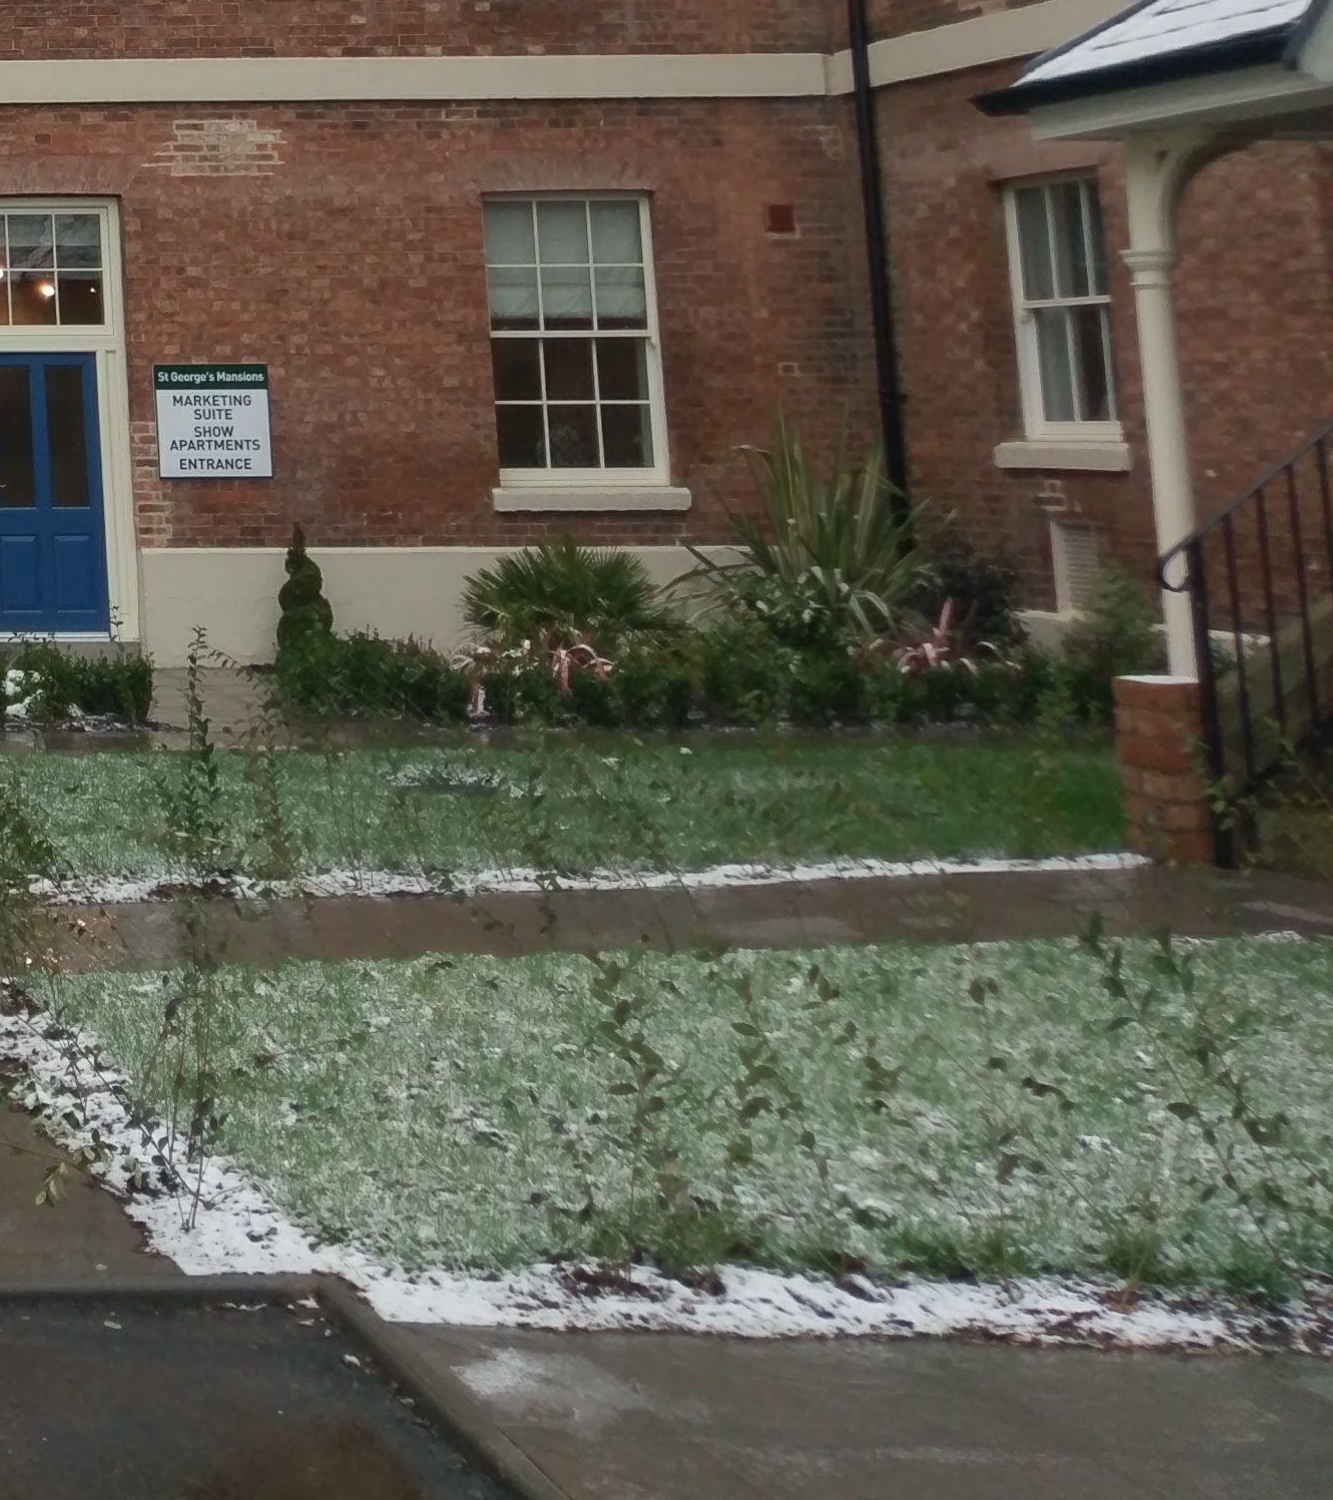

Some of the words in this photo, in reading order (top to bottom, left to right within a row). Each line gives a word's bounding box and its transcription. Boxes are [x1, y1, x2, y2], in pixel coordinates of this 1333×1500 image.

[157, 371, 169, 382] St
[170, 371, 215, 384] George's
[216, 371, 265, 382] Mansions
[172, 395, 252, 406] MARKETING
[193, 408, 233, 420] SUITE
[193, 426, 234, 438] SHOW
[169, 439, 261, 451] APARTMENTS
[179, 458, 252, 470] ENTRANCE
